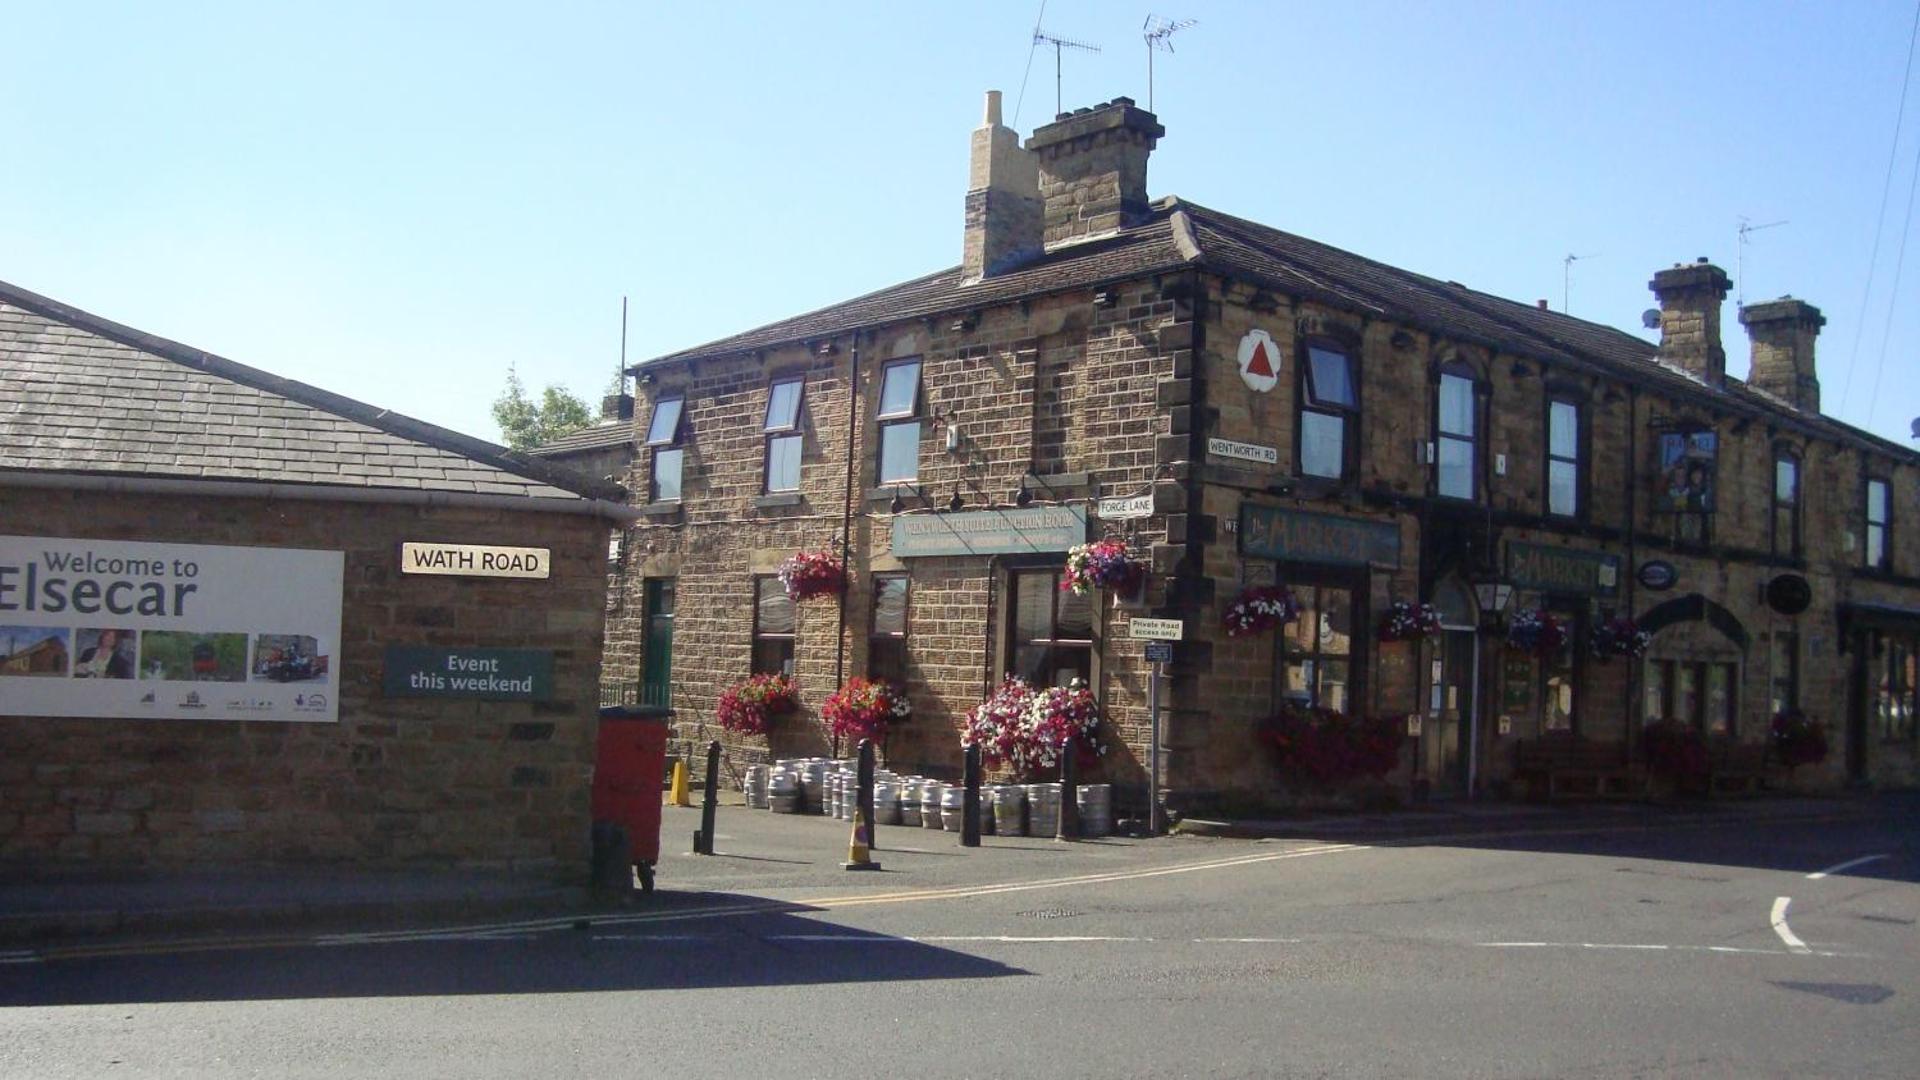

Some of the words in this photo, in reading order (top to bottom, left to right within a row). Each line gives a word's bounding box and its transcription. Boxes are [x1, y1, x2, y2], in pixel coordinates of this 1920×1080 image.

[1210, 440, 1261, 459] WENTWORTH
[1264, 450, 1276, 460] RD
[1101, 501, 1127, 513] FORGE
[1129, 499, 1150, 511] LANE
[1045, 511, 1073, 529] ROOM
[44, 551, 165, 576] Welcome
[173, 558, 199, 578] to
[413, 549, 474, 569] WATH
[482, 552, 539, 572] ROAD
[0, 562, 198, 617] Elsecar
[1132, 620, 1159, 629] Private
[1160, 621, 1180, 630] Road
[1160, 629, 1177, 638] only
[447, 655, 499, 673] Event
[410, 671, 445, 689] this
[450, 674, 533, 693] weekend
